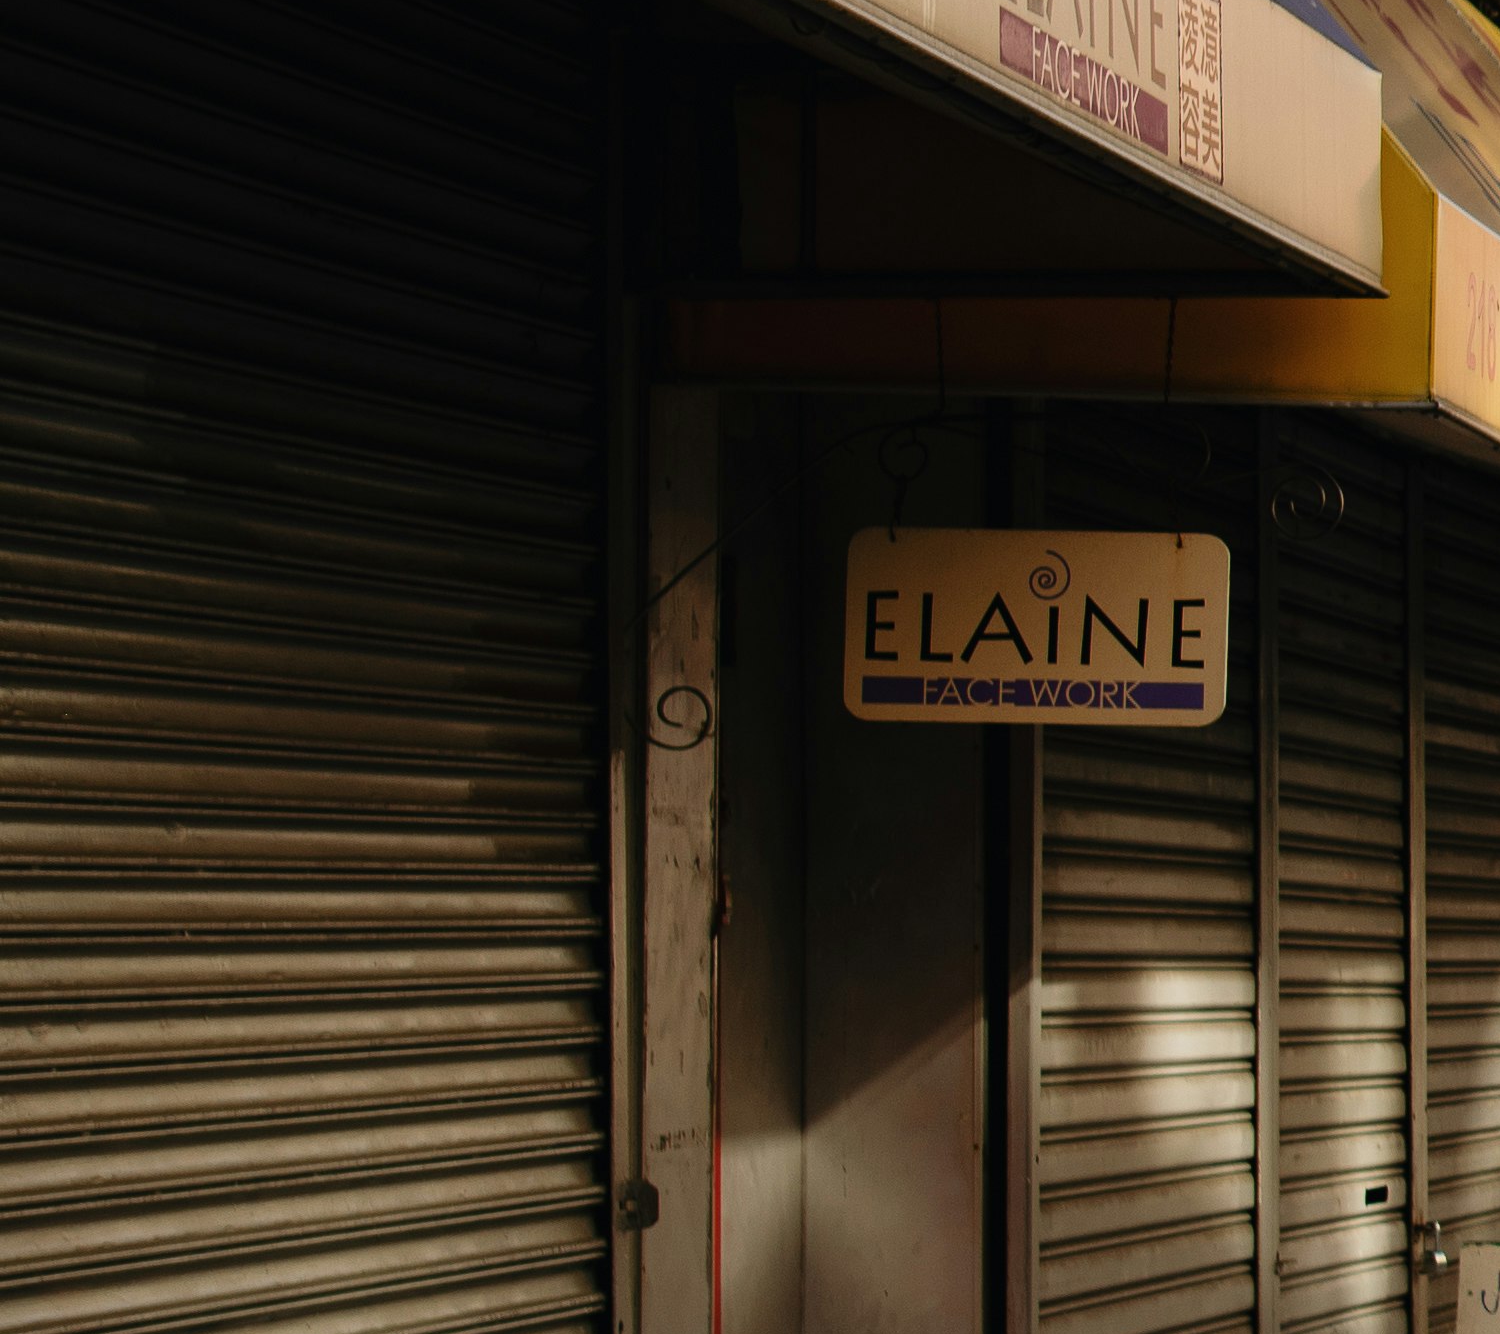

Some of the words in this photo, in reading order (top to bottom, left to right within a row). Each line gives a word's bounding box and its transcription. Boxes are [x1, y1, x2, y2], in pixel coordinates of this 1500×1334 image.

[1031, 24, 1082, 109] FACE
[1083, 55, 1143, 143] WORK
[1465, 271, 1498, 384] 218
[863, 589, 1206, 671] ELAINE
[921, 675, 1017, 707] FACE
[1029, 678, 1143, 711] WORK
